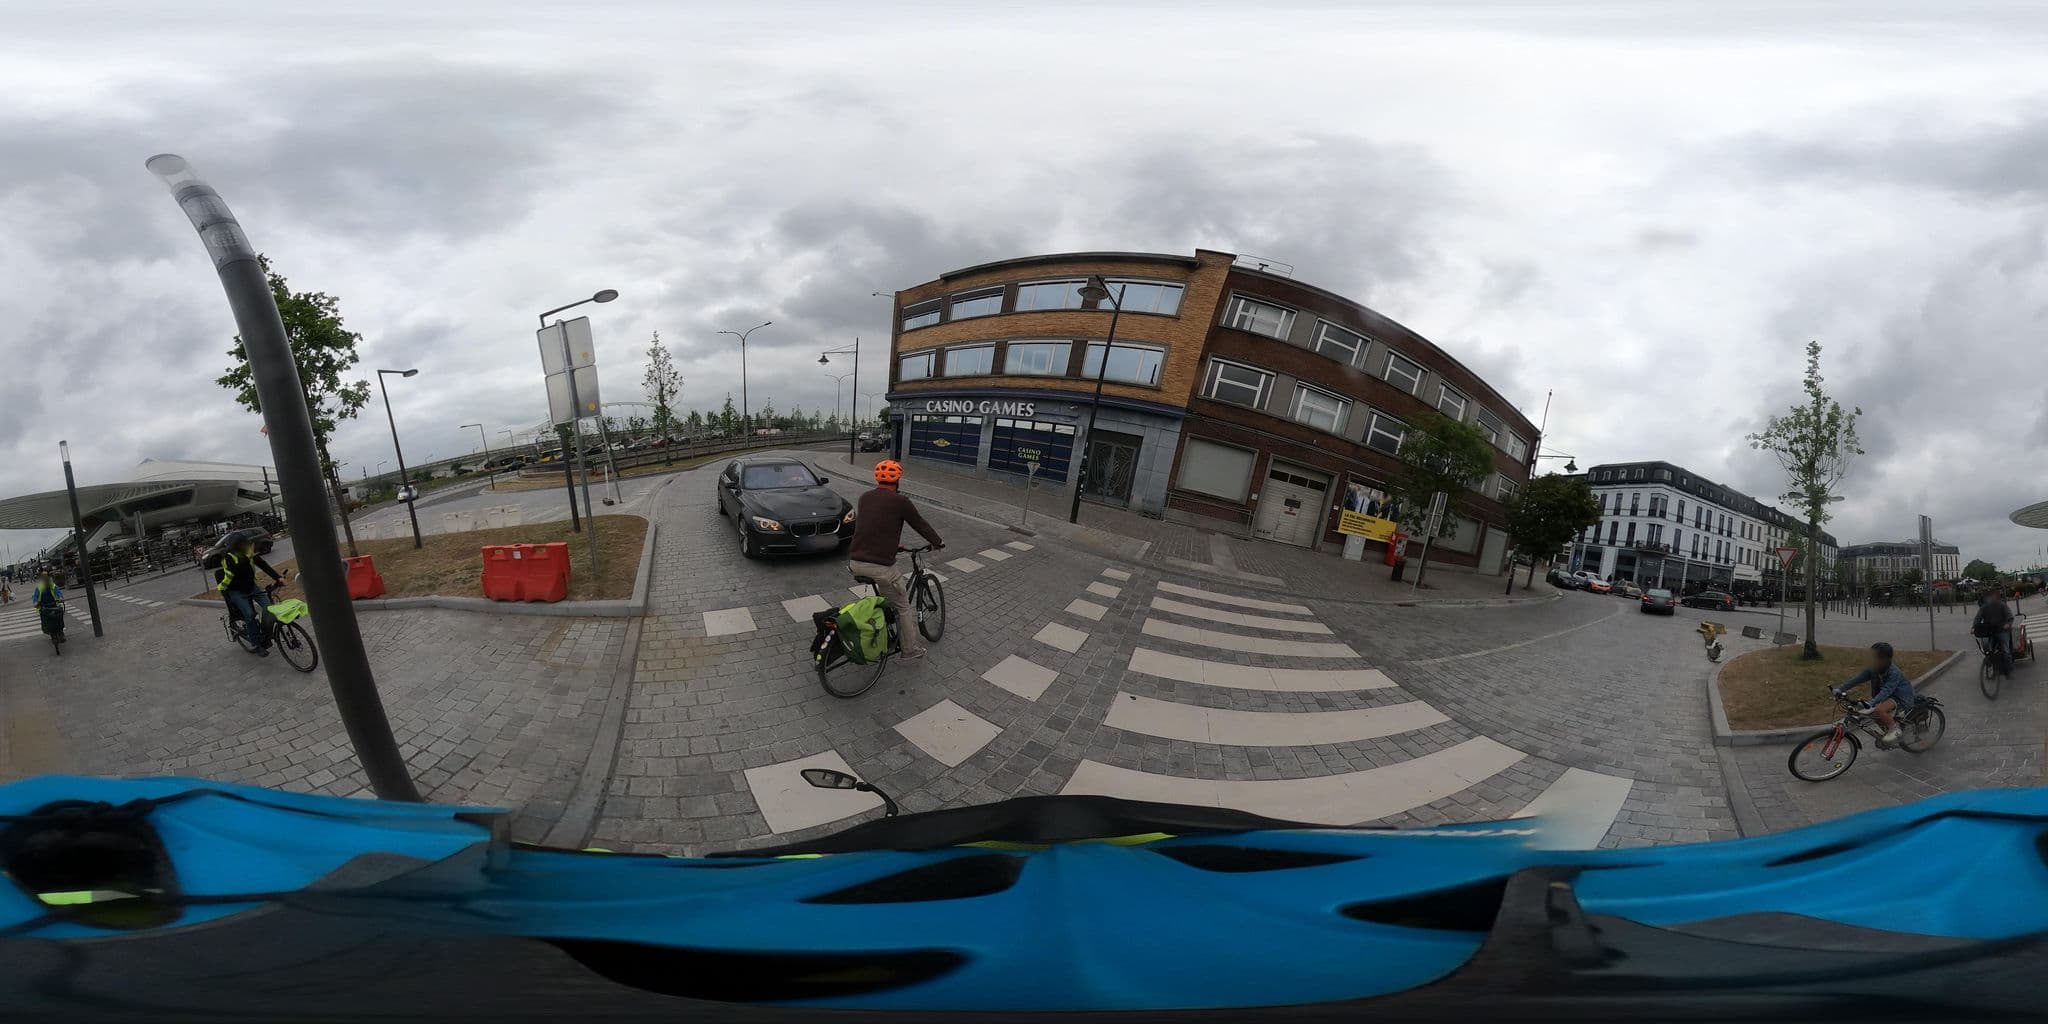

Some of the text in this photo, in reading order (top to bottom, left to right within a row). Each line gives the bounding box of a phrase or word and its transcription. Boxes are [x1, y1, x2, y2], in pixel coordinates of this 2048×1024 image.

[926, 400, 1035, 417] CASINO GAMES
[1017, 447, 1041, 456] CASINO
[1018, 452, 1040, 461] GAMES
